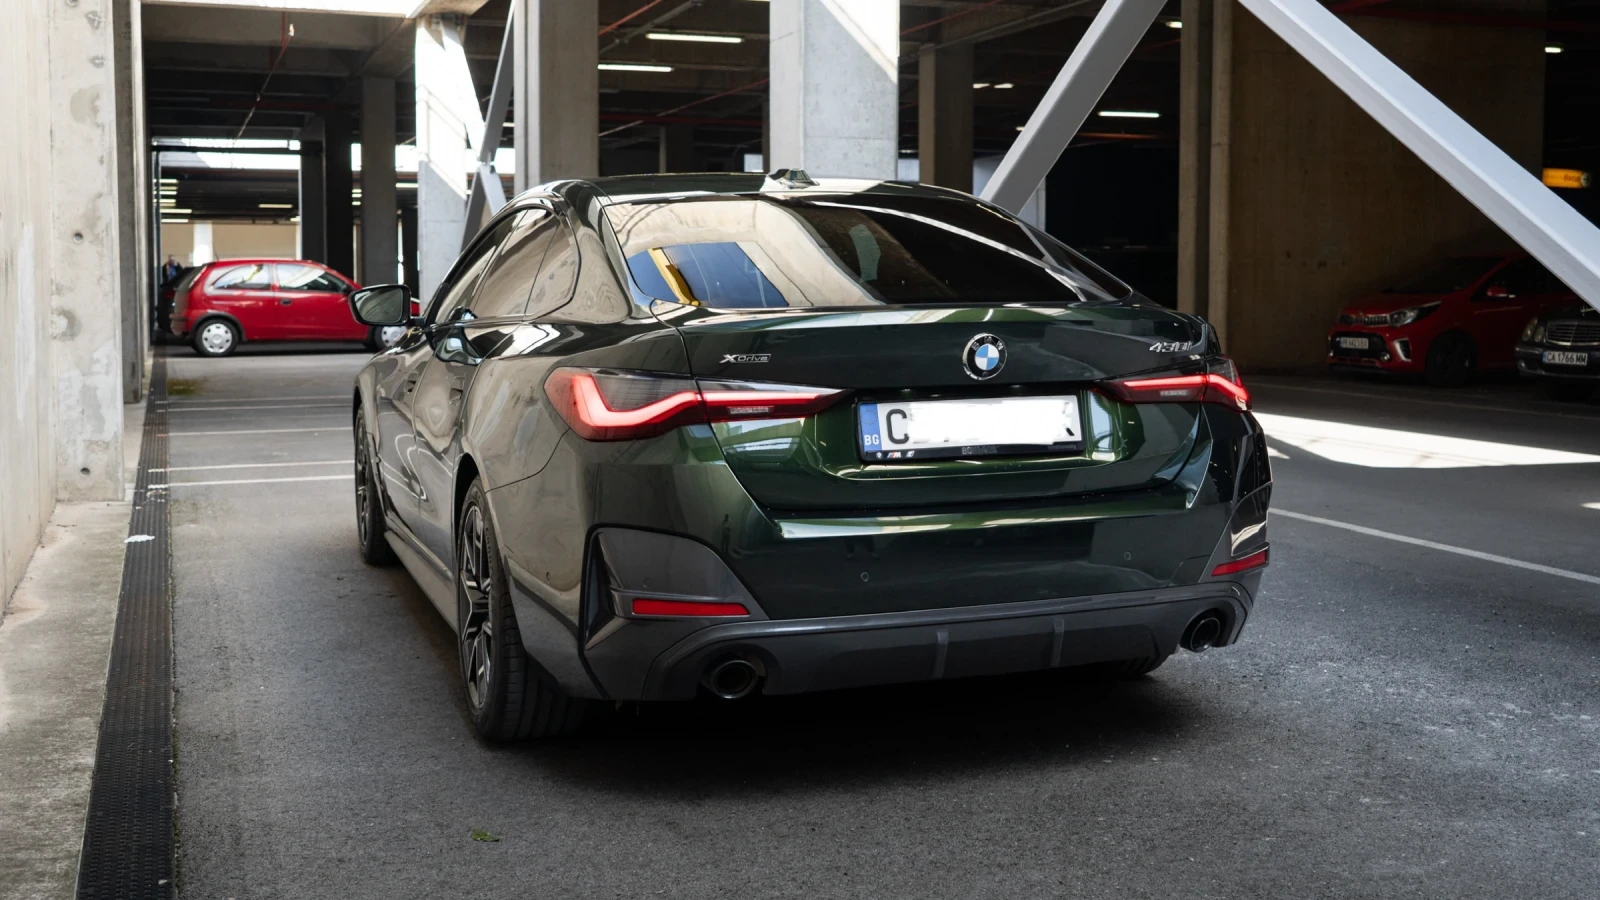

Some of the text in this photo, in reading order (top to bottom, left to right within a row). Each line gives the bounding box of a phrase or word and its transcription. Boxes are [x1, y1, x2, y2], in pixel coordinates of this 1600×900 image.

[1547, 352, 1555, 361] CA
[1558, 352, 1574, 362] 1766
[864, 434, 880, 445] BG
